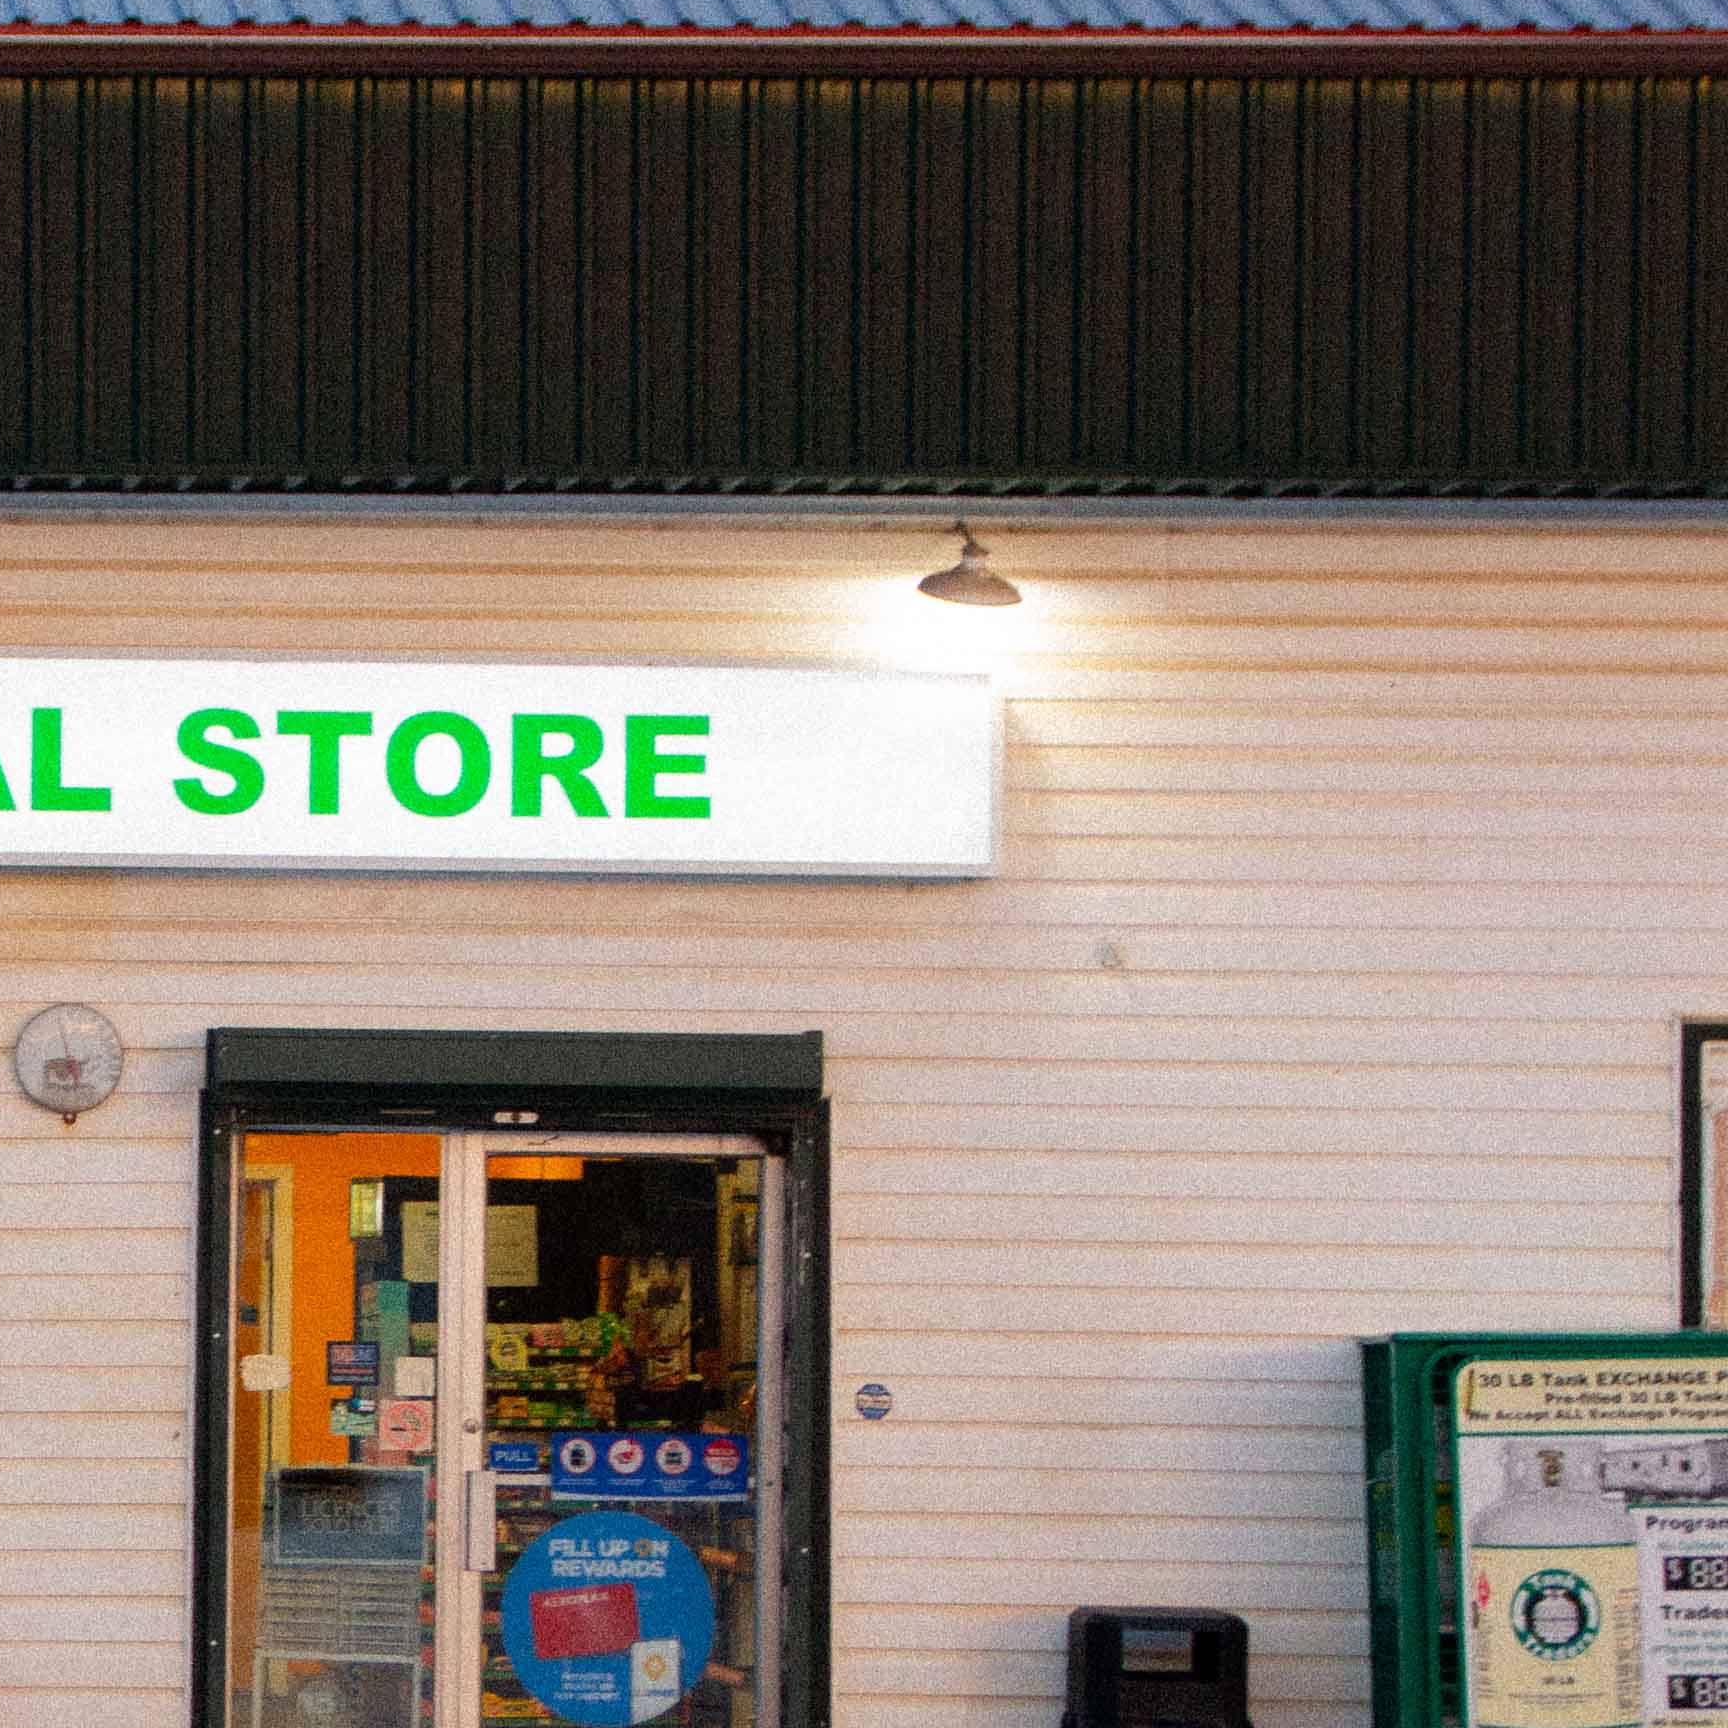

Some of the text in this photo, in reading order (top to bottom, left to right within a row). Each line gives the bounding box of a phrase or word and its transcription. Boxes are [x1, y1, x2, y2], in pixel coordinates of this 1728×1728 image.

[174, 707, 711, 819] STORE
[1478, 1374, 1502, 1387] 30
[1508, 1373, 1534, 1387] LB
[1541, 1372, 1588, 1386] Tank
[1596, 1370, 1709, 1386] EXCHANGE
[1495, 1409, 1551, 1422] Accept
[1555, 1408, 1585, 1420] ALL
[548, 1538, 670, 1559] FILL UP ON
[551, 1559, 668, 1578] REWARDS
